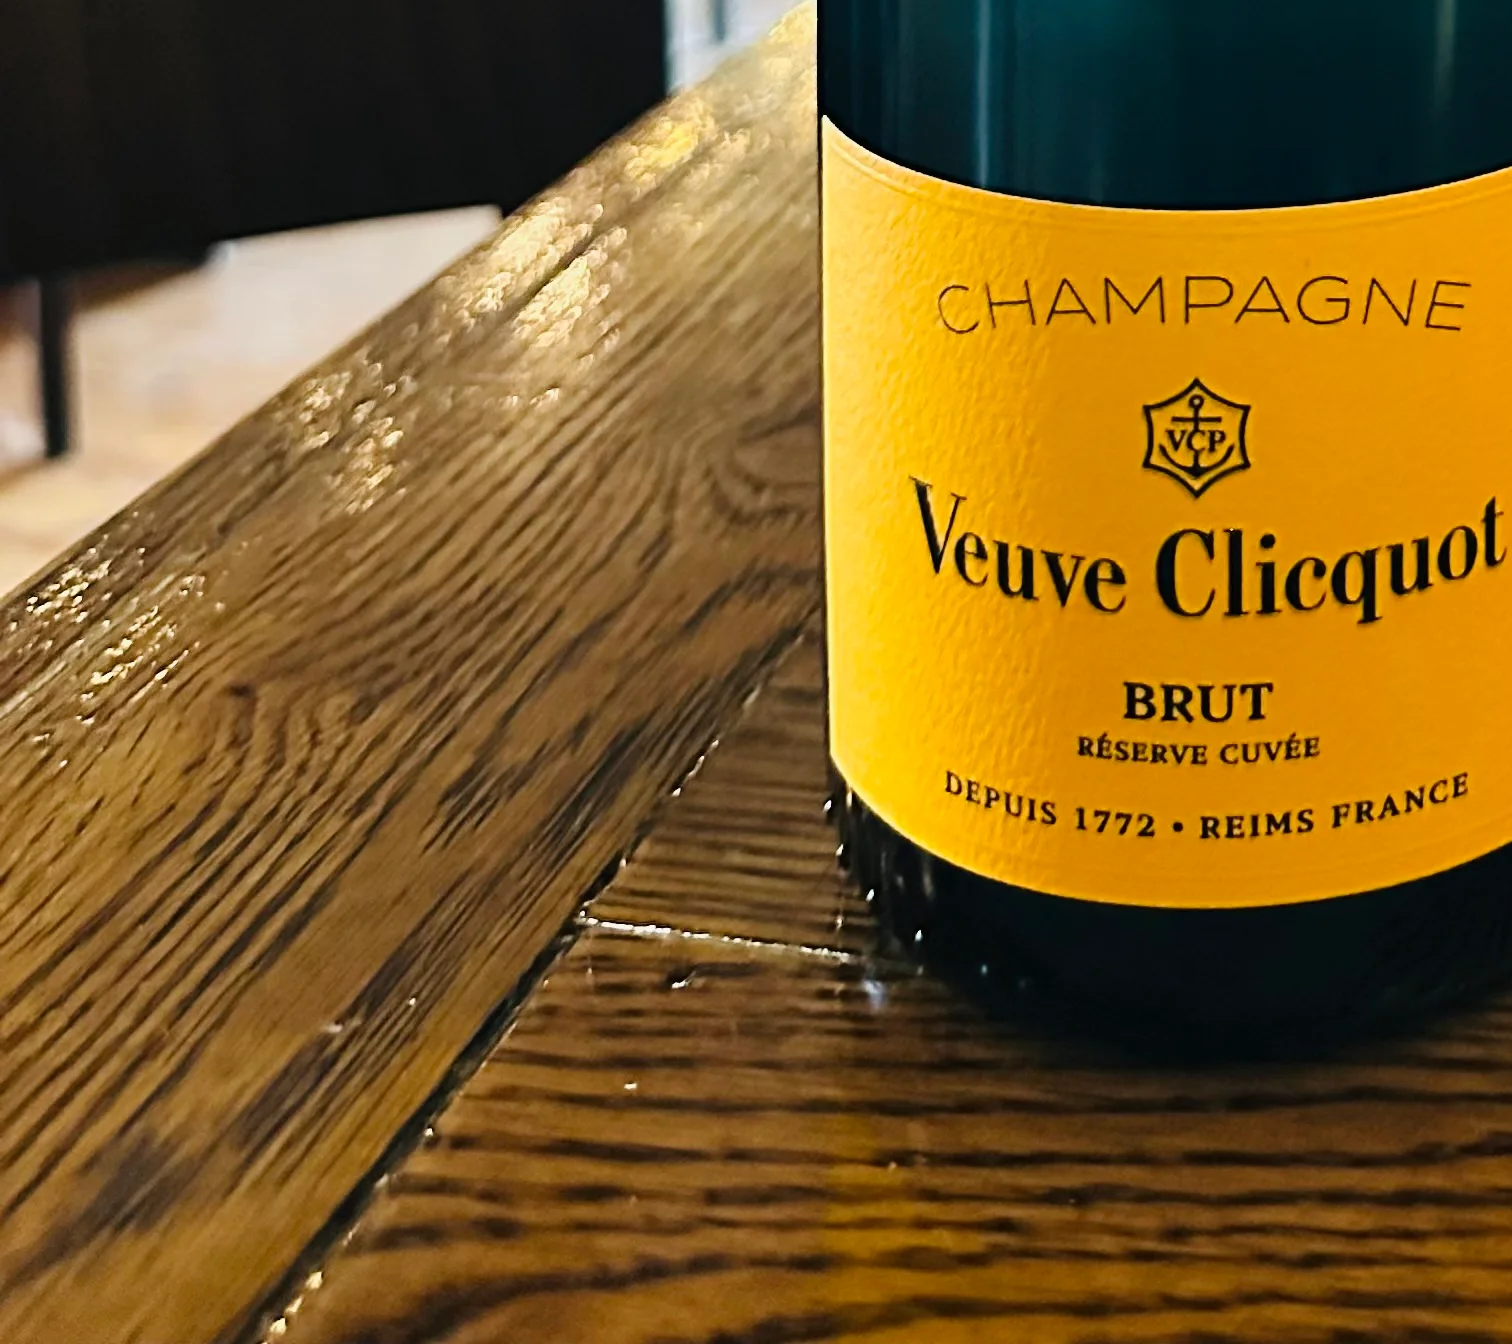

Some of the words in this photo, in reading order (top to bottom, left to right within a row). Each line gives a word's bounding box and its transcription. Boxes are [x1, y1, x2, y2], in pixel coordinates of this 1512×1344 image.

[936, 274, 1473, 334] CHAMPAGNE
[1165, 428, 1226, 454] VCP
[911, 477, 1127, 615] Veuve
[1155, 495, 1508, 627] Clicquot
[1123, 680, 1275, 724] BRUT
[1077, 731, 1208, 766] RÉSERVE
[1219, 731, 1321, 765] CUVÉE
[944, 770, 1058, 828] DEPUIS
[1075, 806, 1156, 839] 1772
[1199, 808, 1315, 840] REIMS
[1331, 771, 1469, 830] FRANCE
